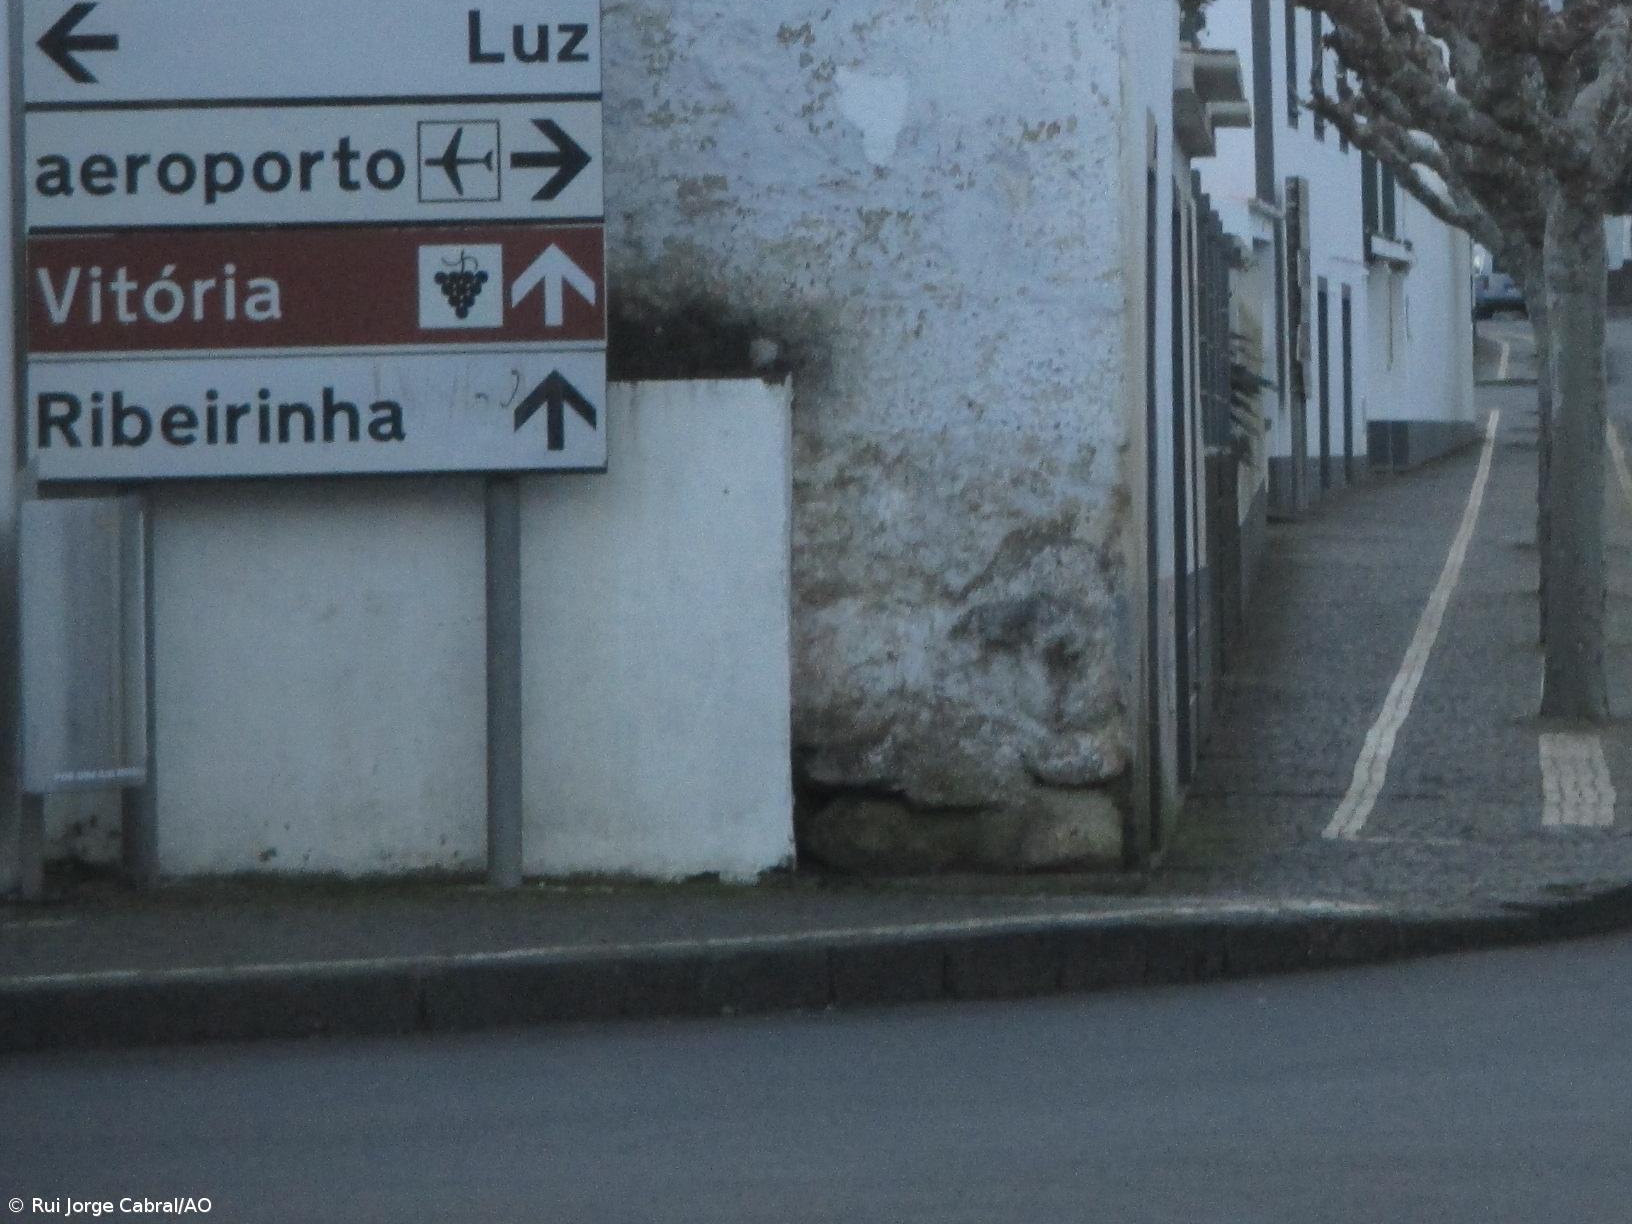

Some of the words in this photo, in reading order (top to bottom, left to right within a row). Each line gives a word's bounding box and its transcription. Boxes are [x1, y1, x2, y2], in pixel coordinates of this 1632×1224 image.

[468, 9, 590, 64] Luz
[35, 136, 407, 204] aeroporto
[38, 263, 283, 324] Vitória
[37, 387, 407, 449] Ribeirinha
